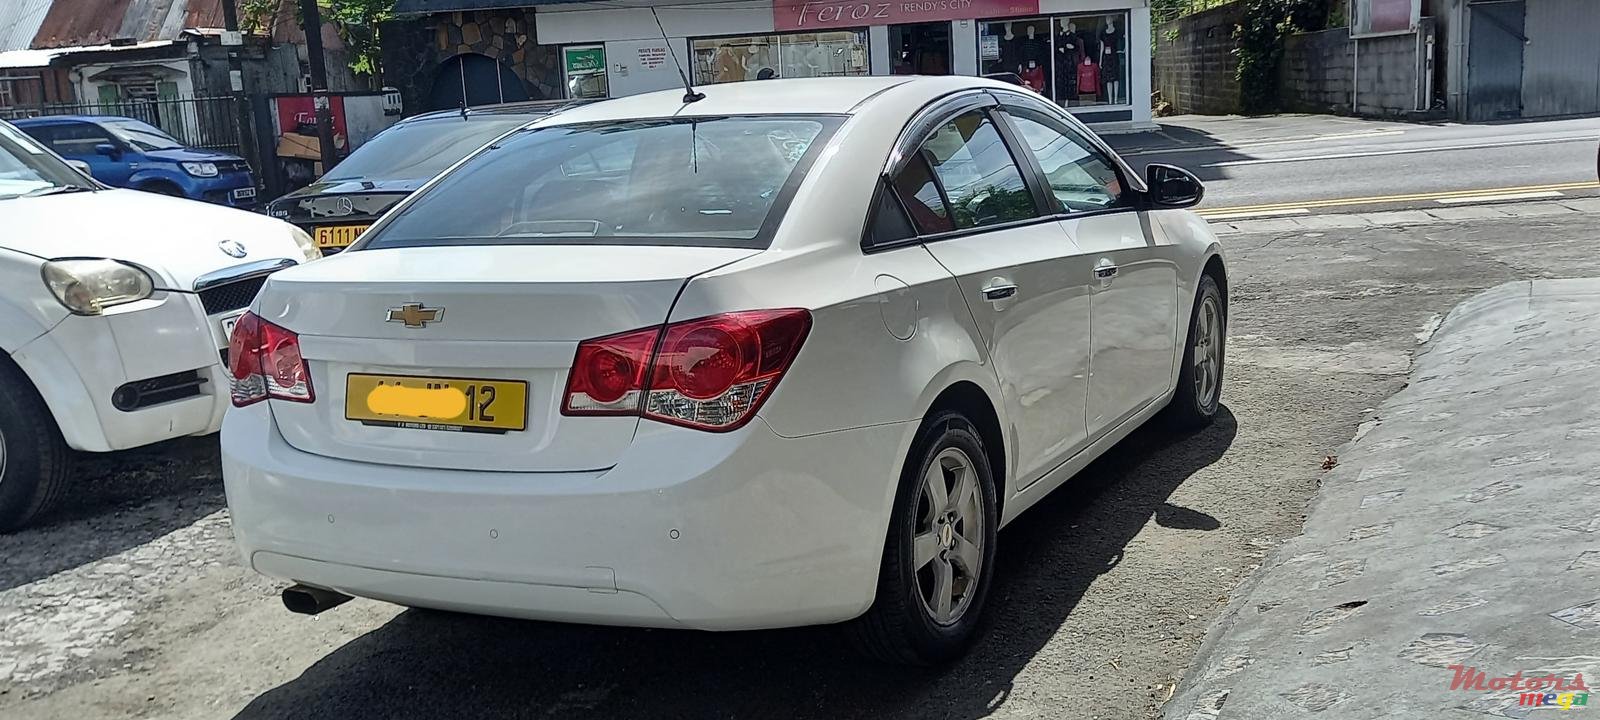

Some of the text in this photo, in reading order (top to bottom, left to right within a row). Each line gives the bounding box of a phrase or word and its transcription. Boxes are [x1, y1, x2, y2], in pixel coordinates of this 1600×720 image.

[792, 1, 892, 26] Feroz
[900, 0, 972, 12] TRENDY'S CITY
[320, 227, 350, 245] 6111
[465, 385, 496, 422] 12
